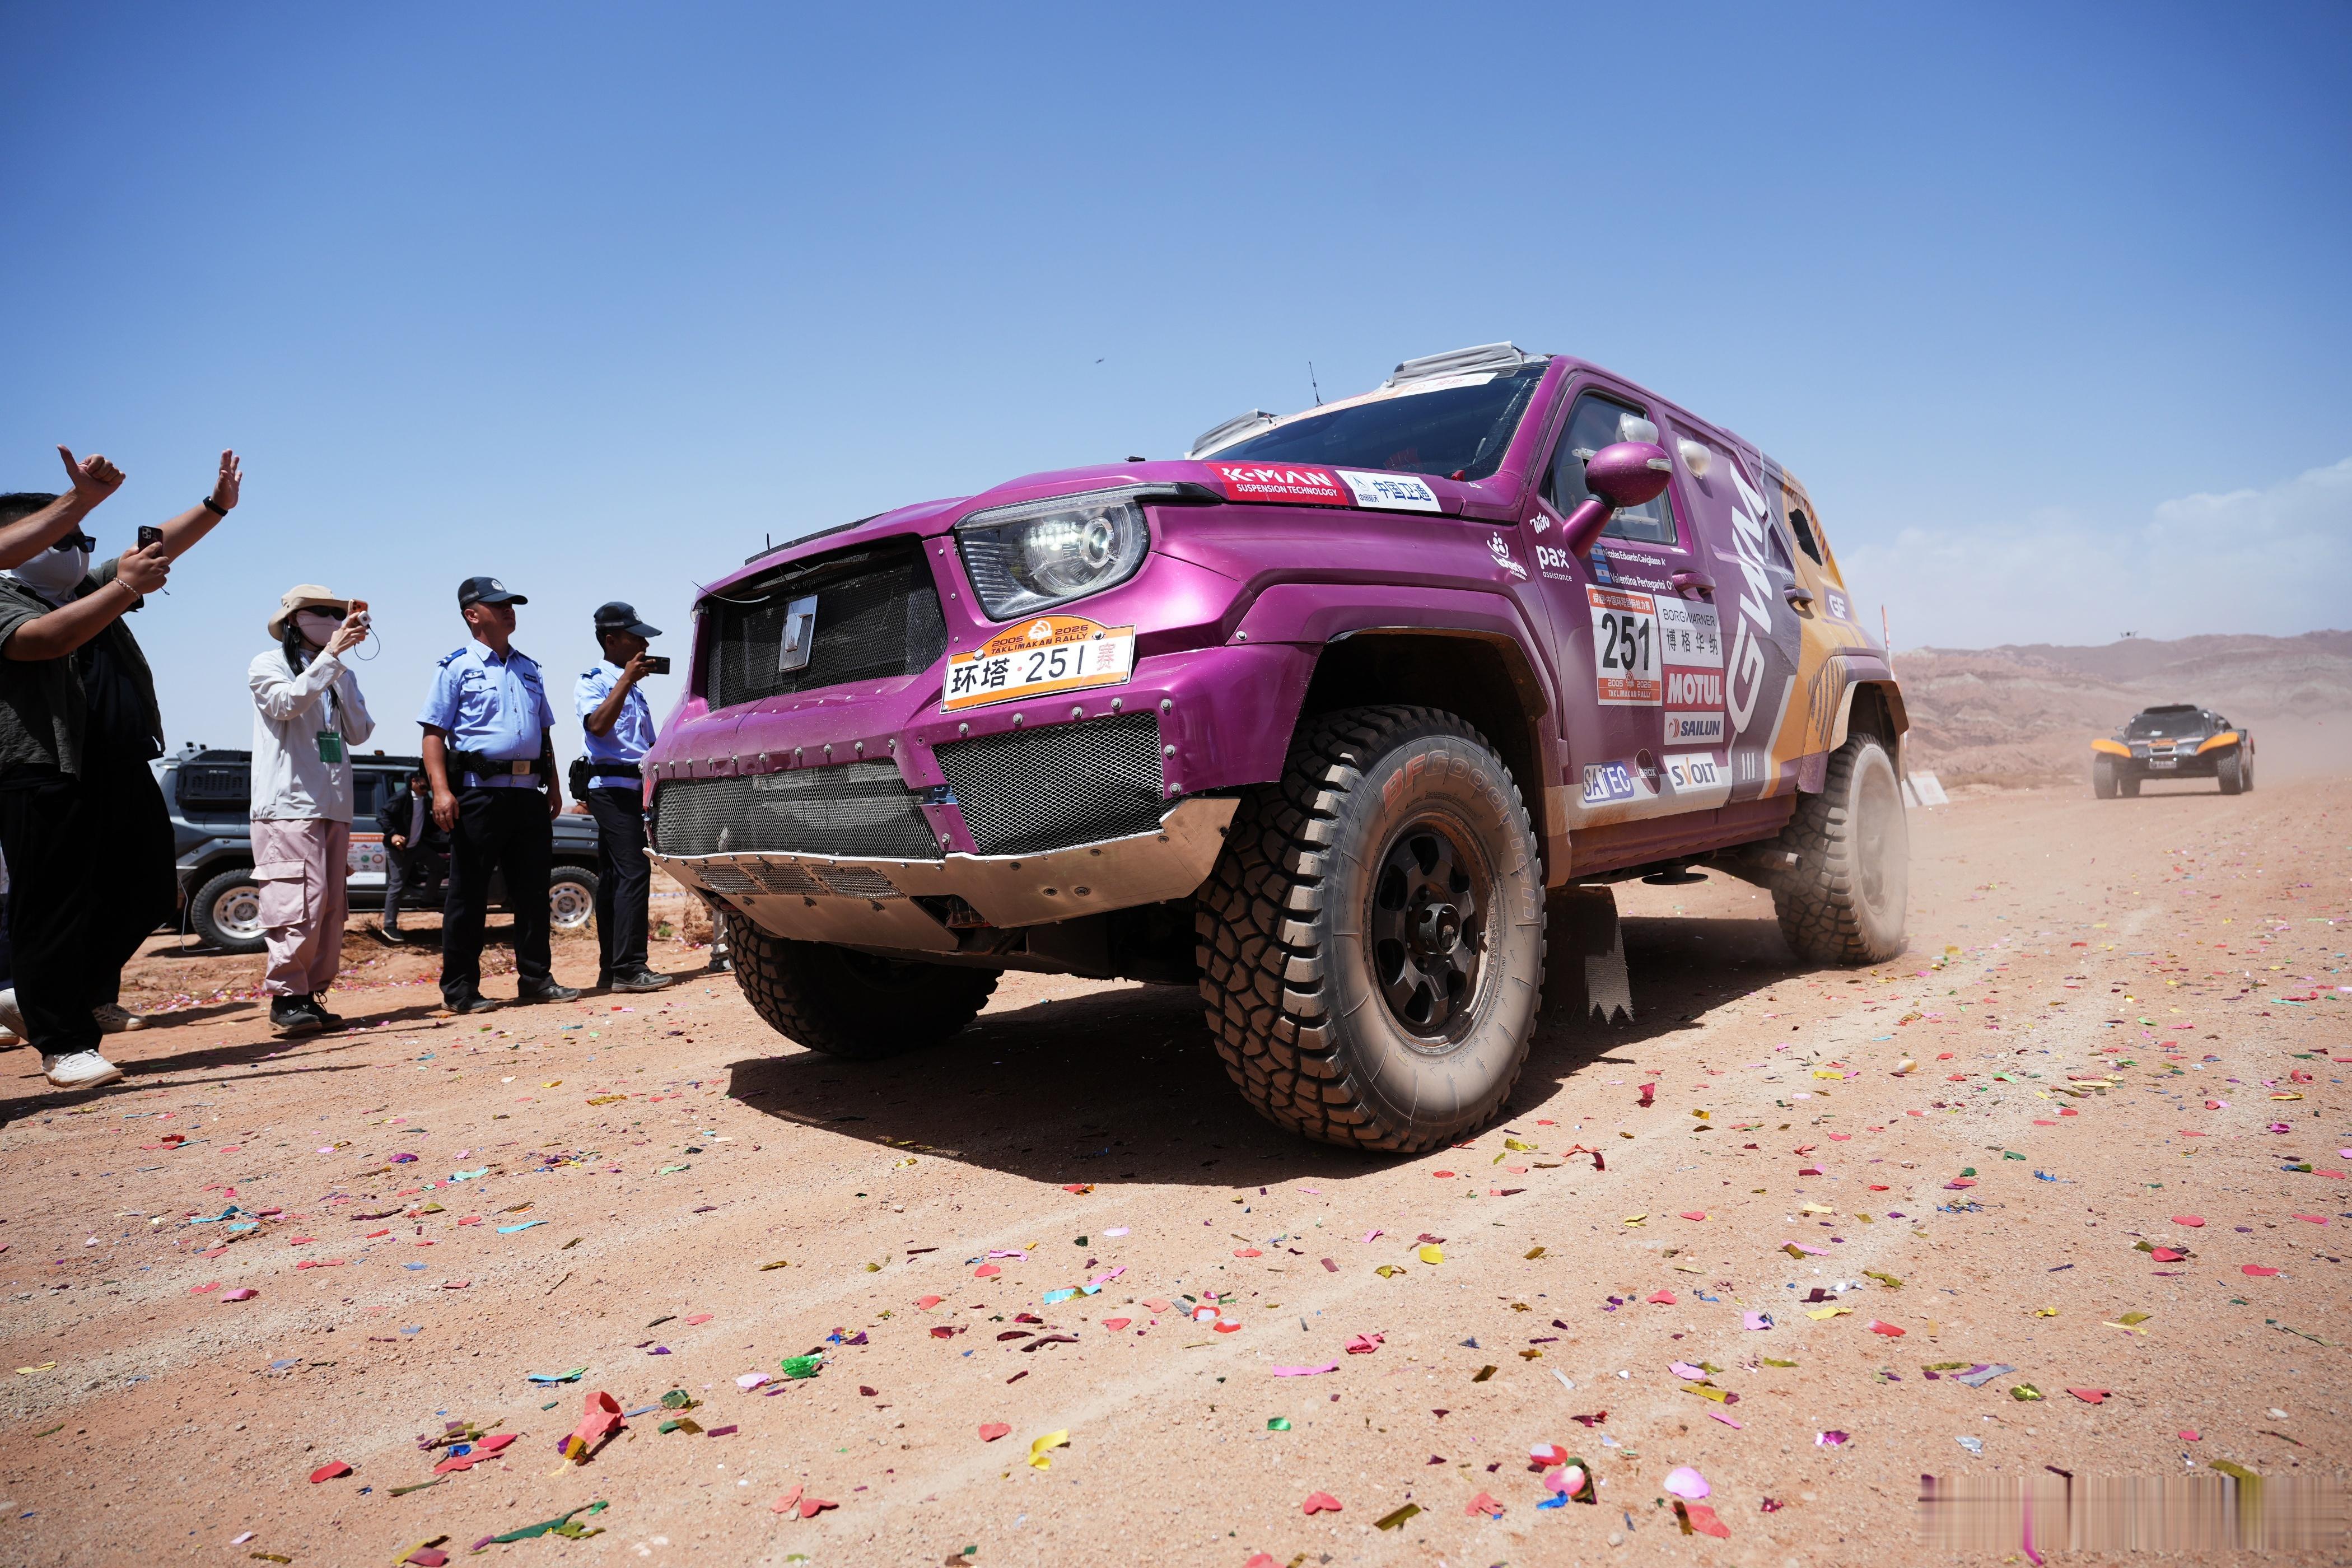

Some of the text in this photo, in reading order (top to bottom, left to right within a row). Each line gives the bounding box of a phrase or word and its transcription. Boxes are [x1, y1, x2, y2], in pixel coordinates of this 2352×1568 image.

[1221, 468, 1333, 486] K-MAN
[1236, 484, 1337, 497] SUSPENSION TECHNOLOGY
[1359, 493, 1380, 503] 中国航天
[1372, 479, 1431, 501] 中国卫通
[1603, 548, 1620, 559] Nicolas
[1620, 551, 1639, 562] Eduardo
[1638, 554, 1661, 566] Cavigliasso
[1543, 571, 1572, 582] assistance
[1610, 572, 1637, 586] Valentina
[1636, 577, 1666, 591] Pertegarini
[1726, 461, 1772, 732] GWM
[1663, 609, 1715, 626] BORGWARNER
[992, 624, 1088, 647] 2005 2026
[992, 633, 1088, 655] TAKLIMAKAN RALLY
[1602, 613, 1649, 670] 251
[1667, 628, 1718, 656] 博格华纳
[1096, 642, 1116, 671] 赛
[1608, 689, 1637, 698] TAKLIMAKAN
[1637, 680, 1651, 688] 2026
[1667, 673, 1722, 705] MOTUL
[1681, 720, 1720, 736] SAILUN
[1584, 765, 1630, 797] SATEC
[1672, 757, 1715, 786] SVOLT
[1382, 750, 1536, 919] BFGoodrich
